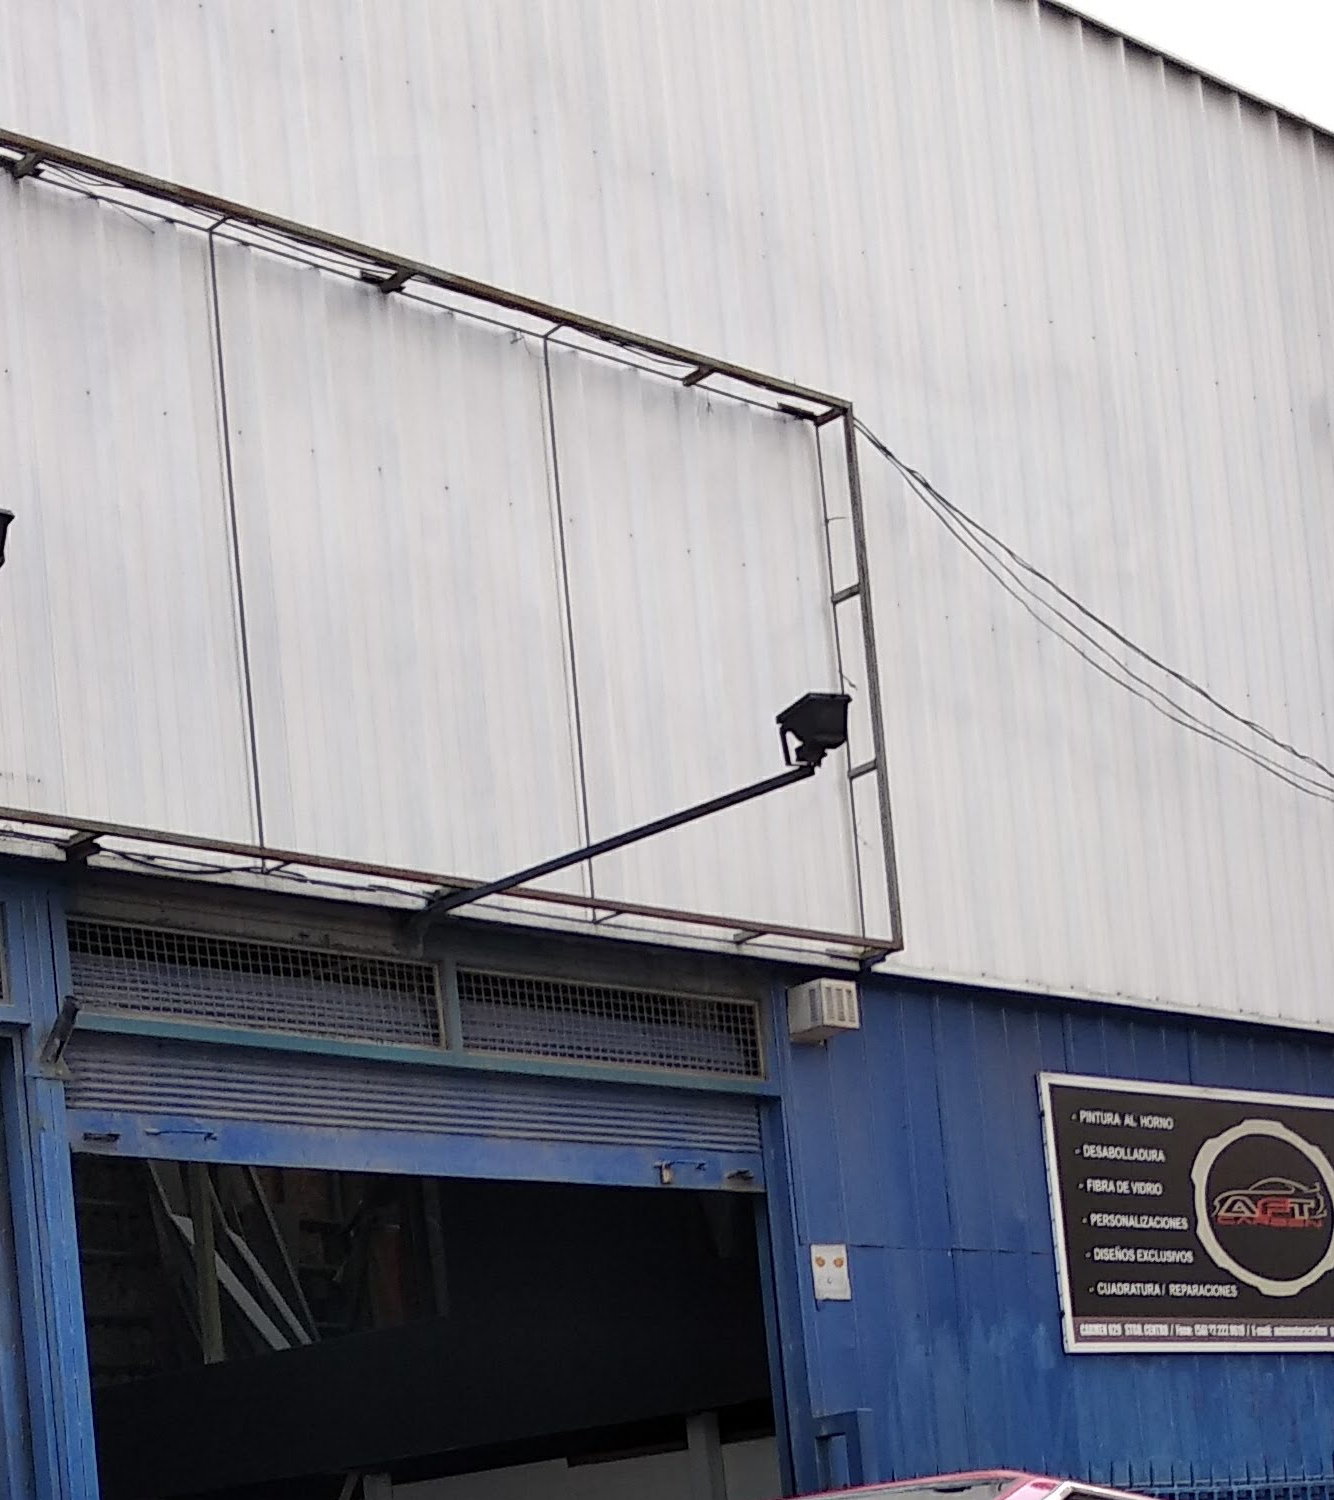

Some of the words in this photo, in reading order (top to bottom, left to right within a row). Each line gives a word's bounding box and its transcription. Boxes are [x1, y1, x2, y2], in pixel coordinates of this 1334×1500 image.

[1079, 1109, 1121, 1126] PINTURA
[1123, 1114, 1137, 1128] AL
[1139, 1115, 1174, 1131] HORNO
[1082, 1144, 1166, 1163] DESABOLLADURA
[1086, 1178, 1115, 1193] FIBRA
[1116, 1181, 1130, 1194] DE
[1131, 1181, 1163, 1196] VIDRIO
[1090, 1213, 1188, 1231] PERSONALIZACIONES
[1093, 1246, 1135, 1262] DISEÑOS
[1136, 1249, 1194, 1264] EXCLUSIVOS
[1168, 1284, 1238, 1298] REPARACIONES
